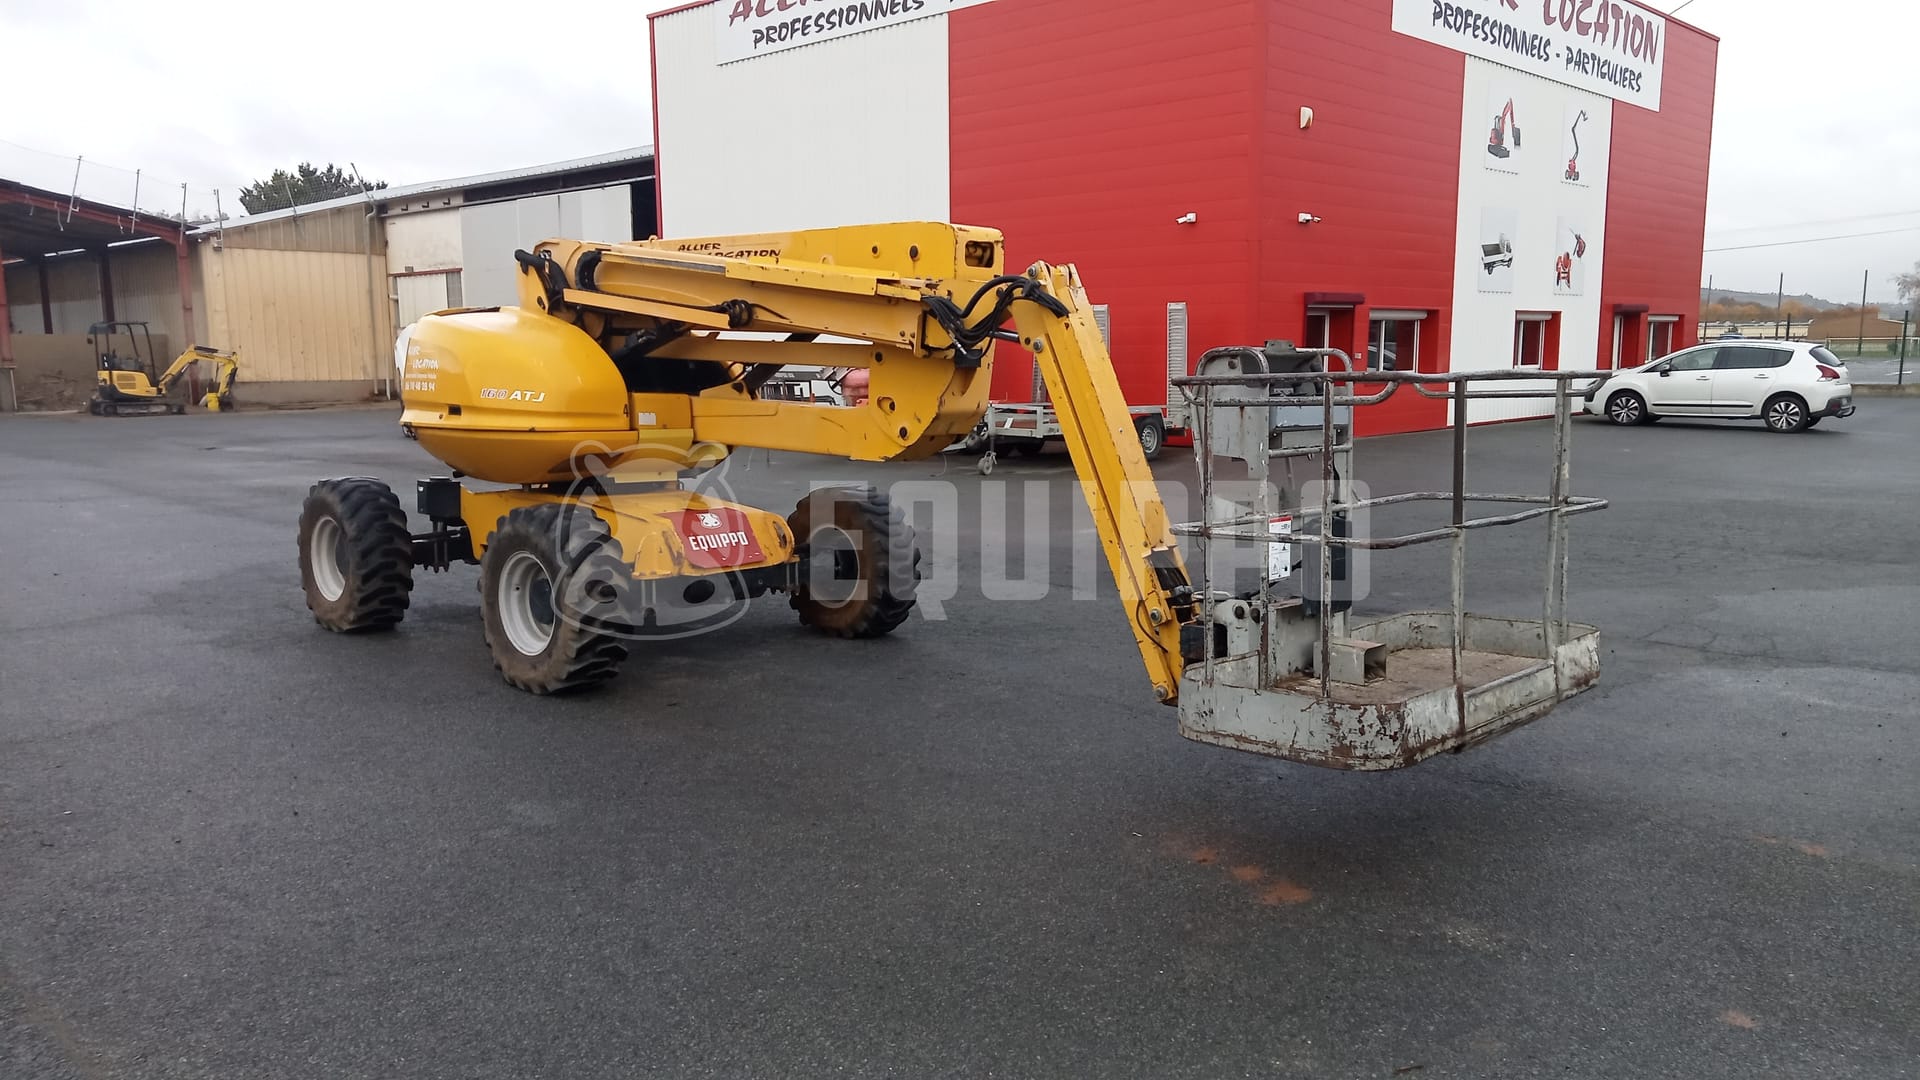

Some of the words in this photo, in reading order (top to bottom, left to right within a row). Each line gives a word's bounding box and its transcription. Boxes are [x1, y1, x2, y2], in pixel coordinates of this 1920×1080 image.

[752, 0, 924, 48] PROFESSIONNELS
[1543, 0, 1660, 64] LOCATION
[1432, 0, 1551, 62] PROFESSIONNELS
[1566, 45, 1642, 92] PARTICULIERS
[678, 243, 721, 252] ALLIER
[707, 249, 781, 260] OCATION
[481, 388, 508, 400] 160
[509, 390, 545, 403] ATJ
[688, 531, 749, 552] EQUIPPO
